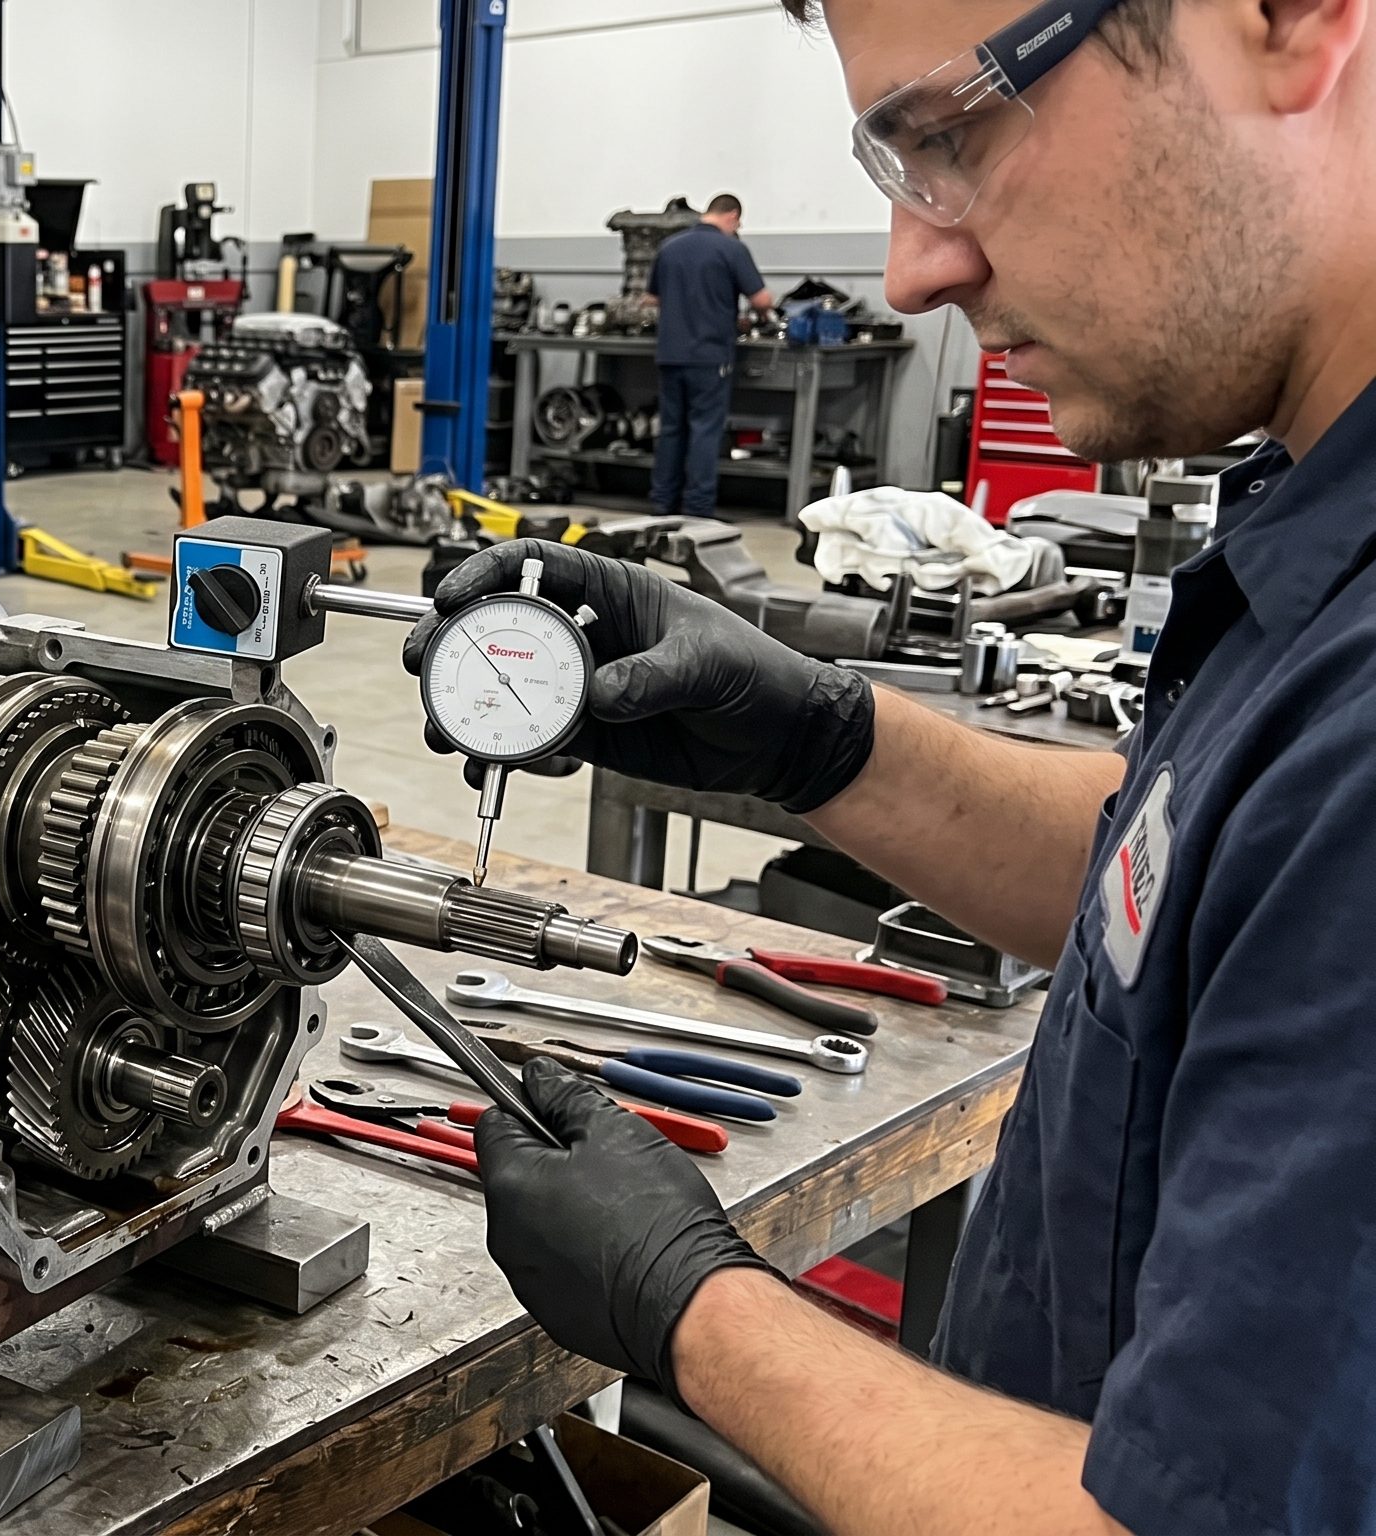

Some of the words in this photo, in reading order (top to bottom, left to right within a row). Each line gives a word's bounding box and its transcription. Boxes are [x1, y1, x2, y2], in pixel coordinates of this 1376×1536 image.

[475, 624, 485, 634] 10
[543, 630, 553, 640] 10
[449, 650, 460, 660] 20
[486, 643, 535, 661] Starrett
[559, 661, 570, 671] 20
[554, 695, 565, 705] 30
